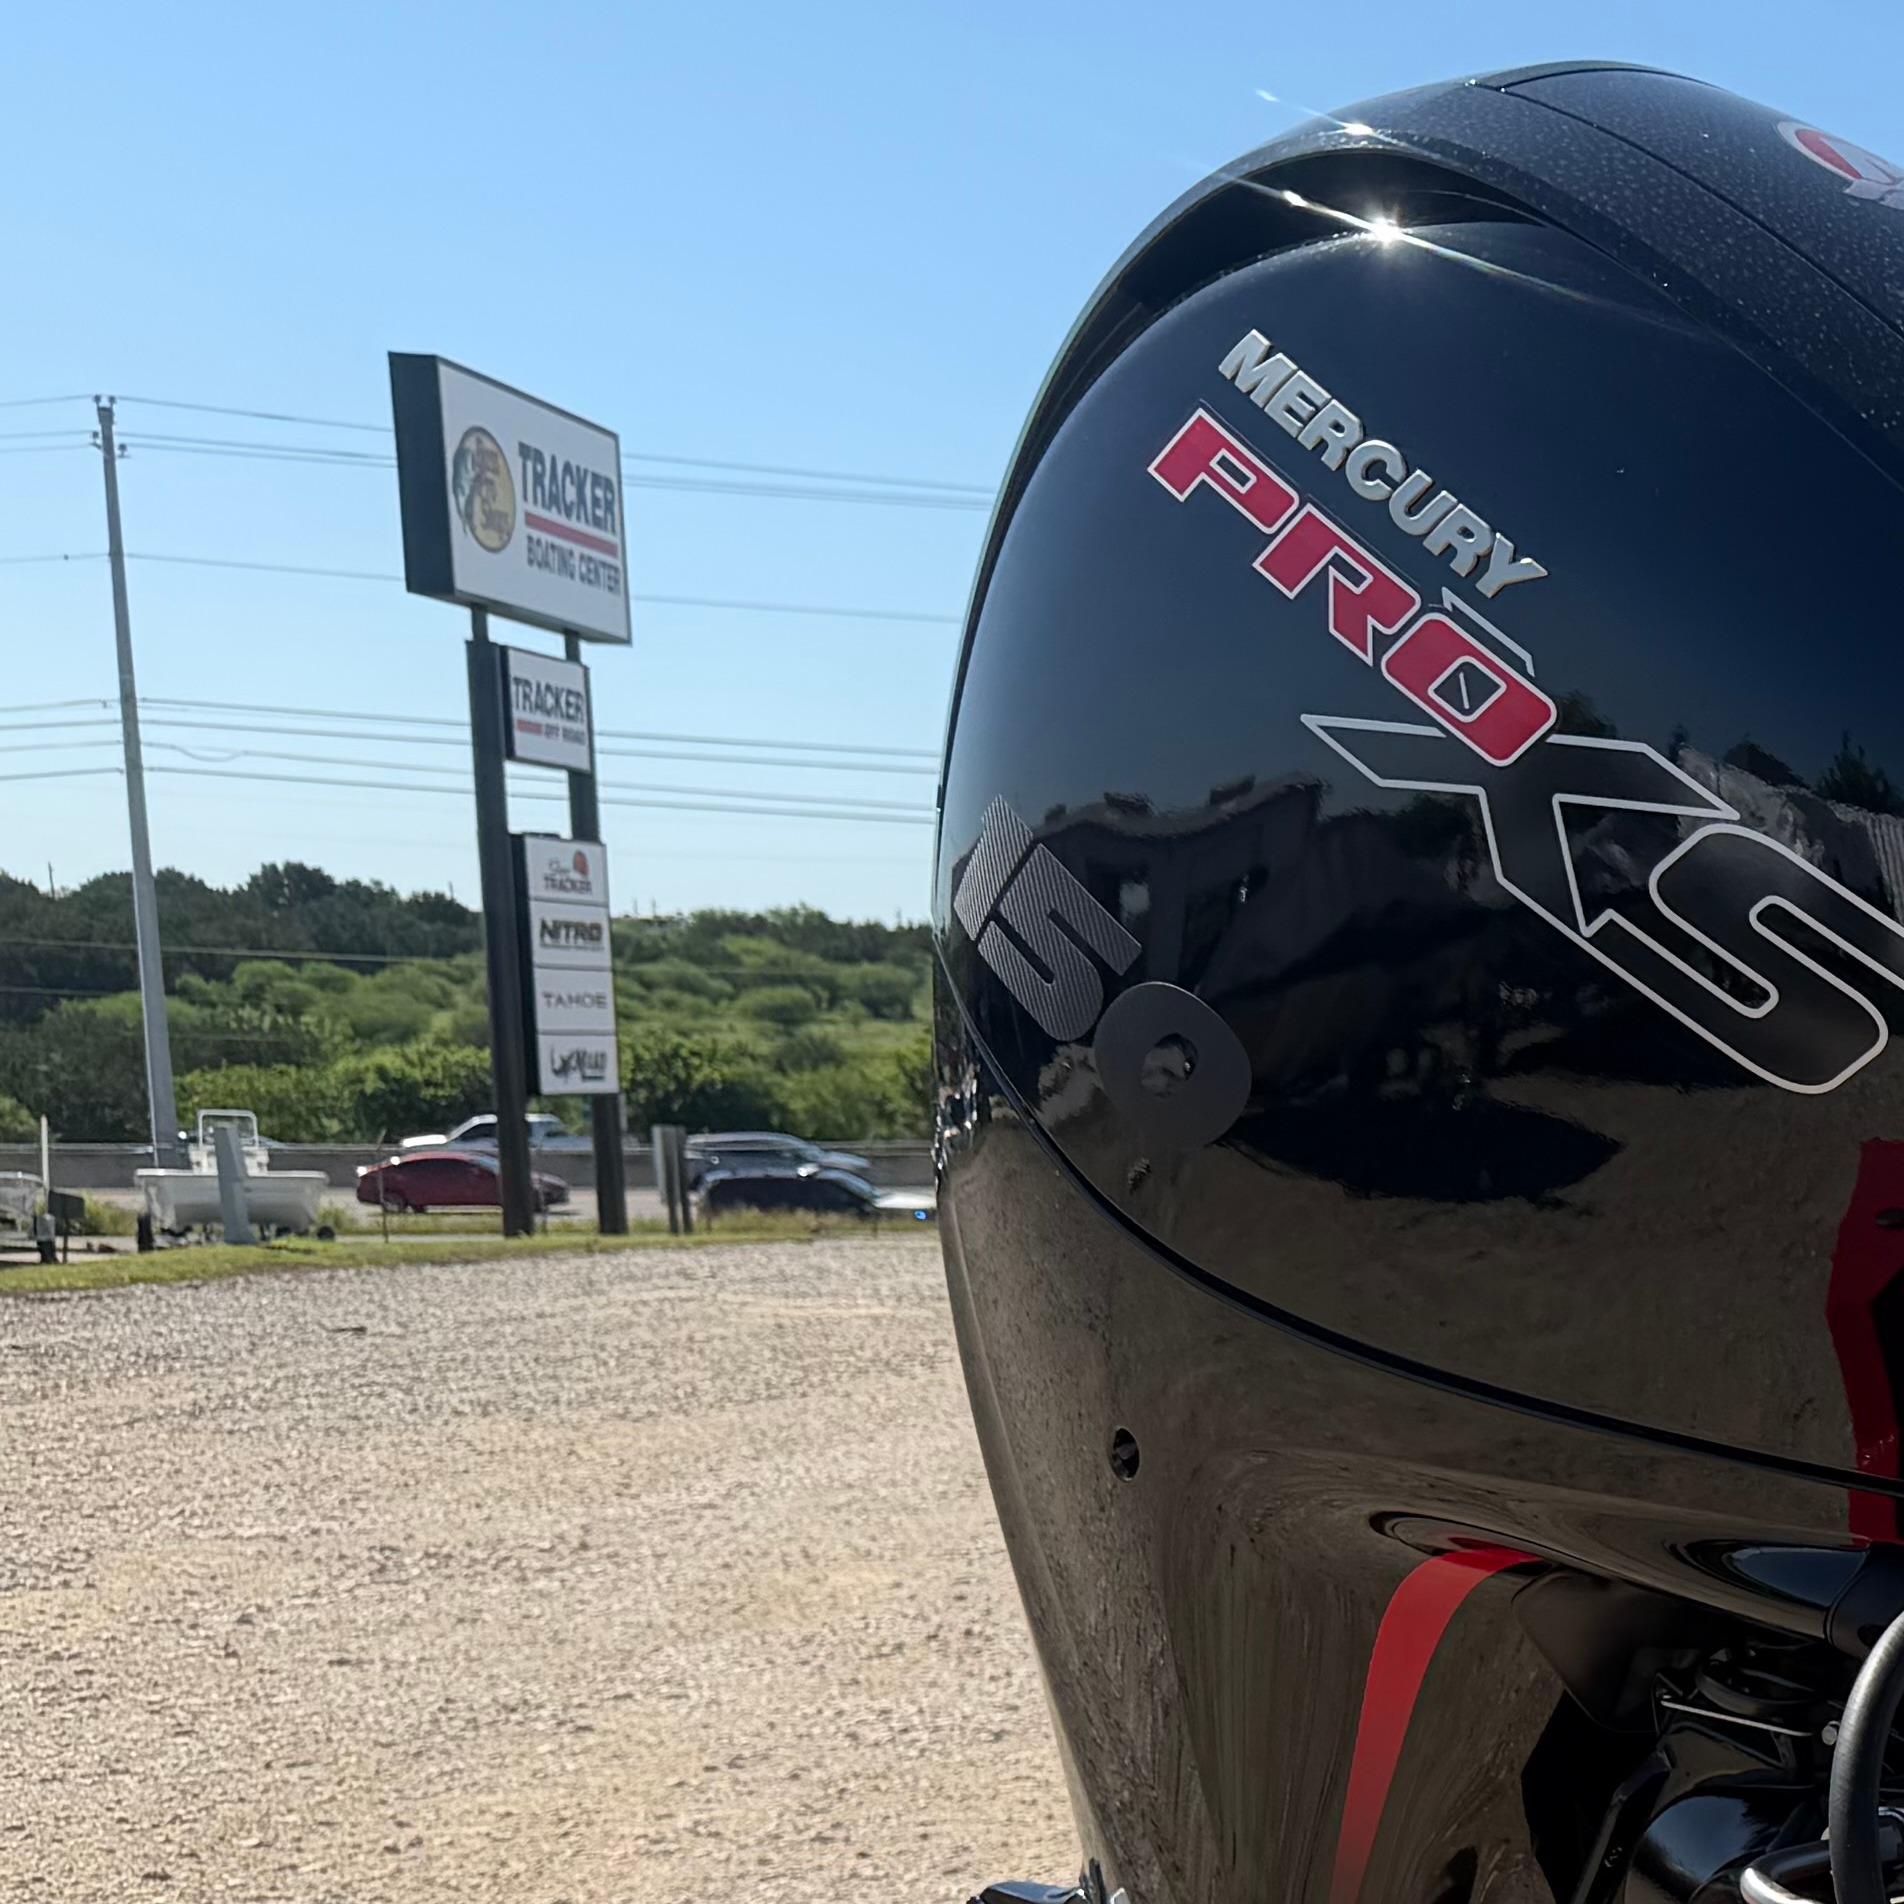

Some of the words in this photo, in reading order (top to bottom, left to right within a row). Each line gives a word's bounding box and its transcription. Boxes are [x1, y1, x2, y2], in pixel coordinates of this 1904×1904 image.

[517, 441, 617, 536] TRACKER
[1219, 329, 1548, 598] MERCURY
[527, 534, 576, 582] BOATING
[579, 552, 621, 598] CENTER
[1147, 408, 1557, 767] PRO
[512, 676, 585, 724] TRACKER
[544, 875, 592, 896] TRACKER
[540, 918, 604, 946] NITRO
[542, 990, 608, 1010] TAHOE
